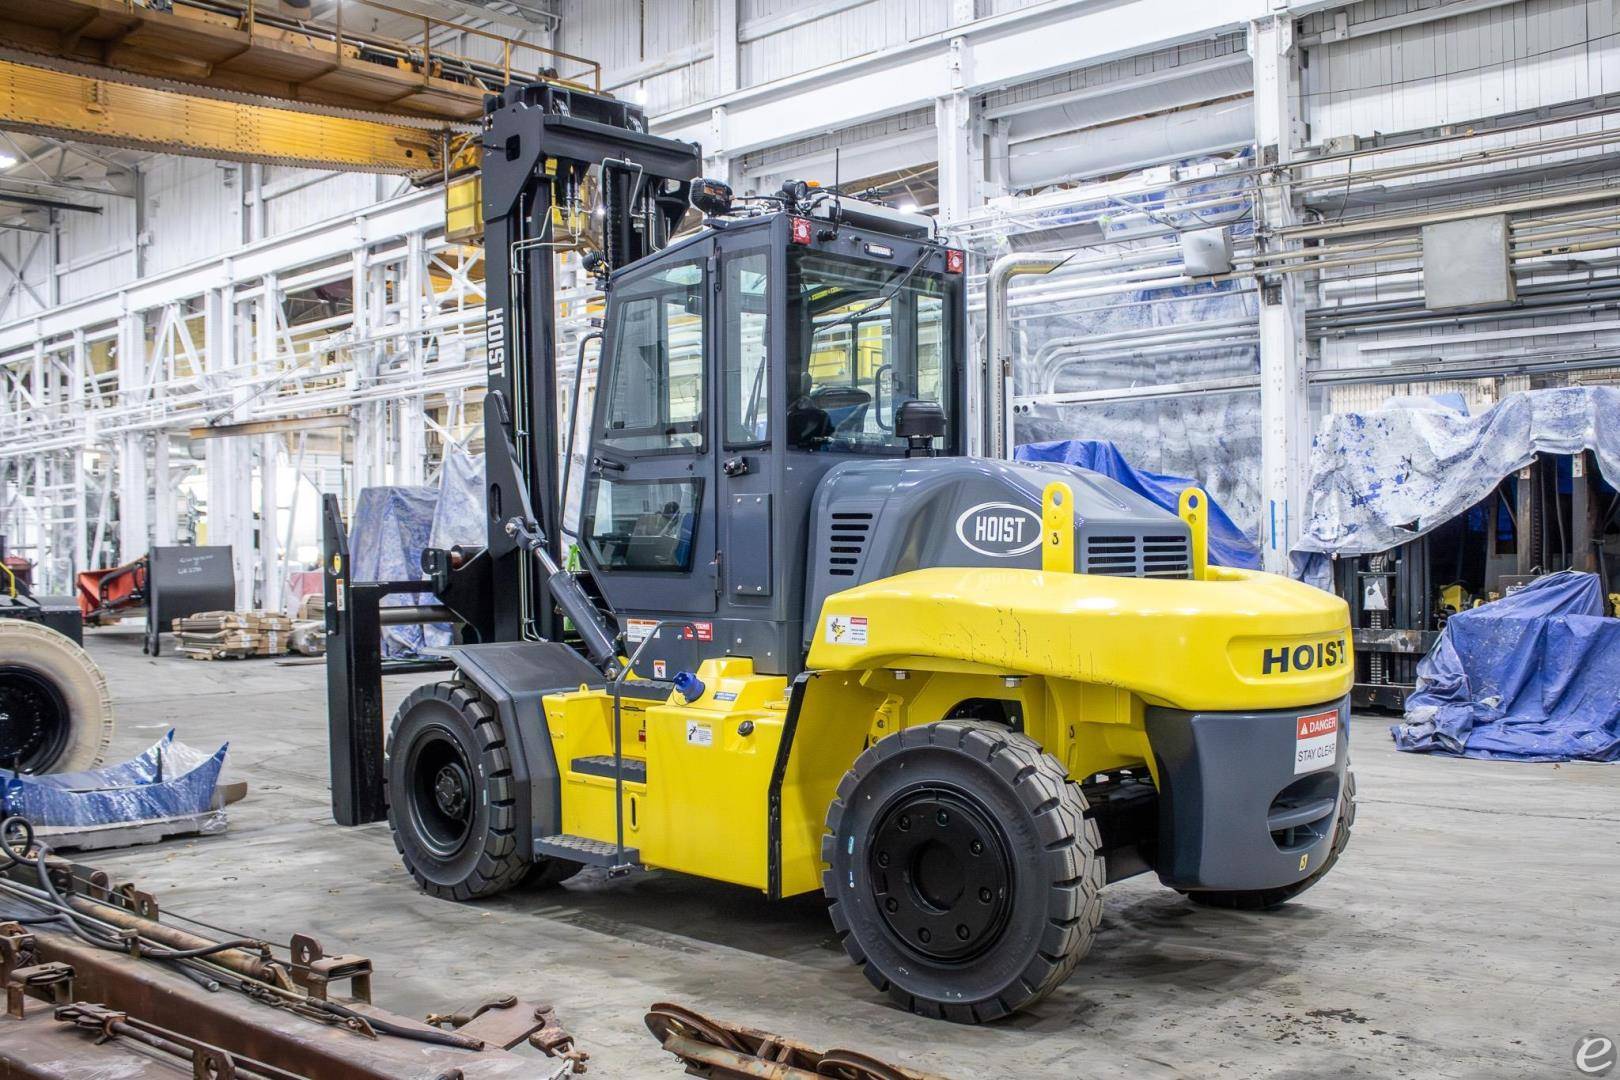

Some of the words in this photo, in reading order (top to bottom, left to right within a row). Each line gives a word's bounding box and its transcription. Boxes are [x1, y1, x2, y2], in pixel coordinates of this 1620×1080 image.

[486, 307, 506, 378] HOIST
[975, 515, 1026, 543] HOIST
[1262, 639, 1345, 675] HOIST
[1309, 717, 1336, 733] DANGER
[1297, 748, 1316, 762] STAY
